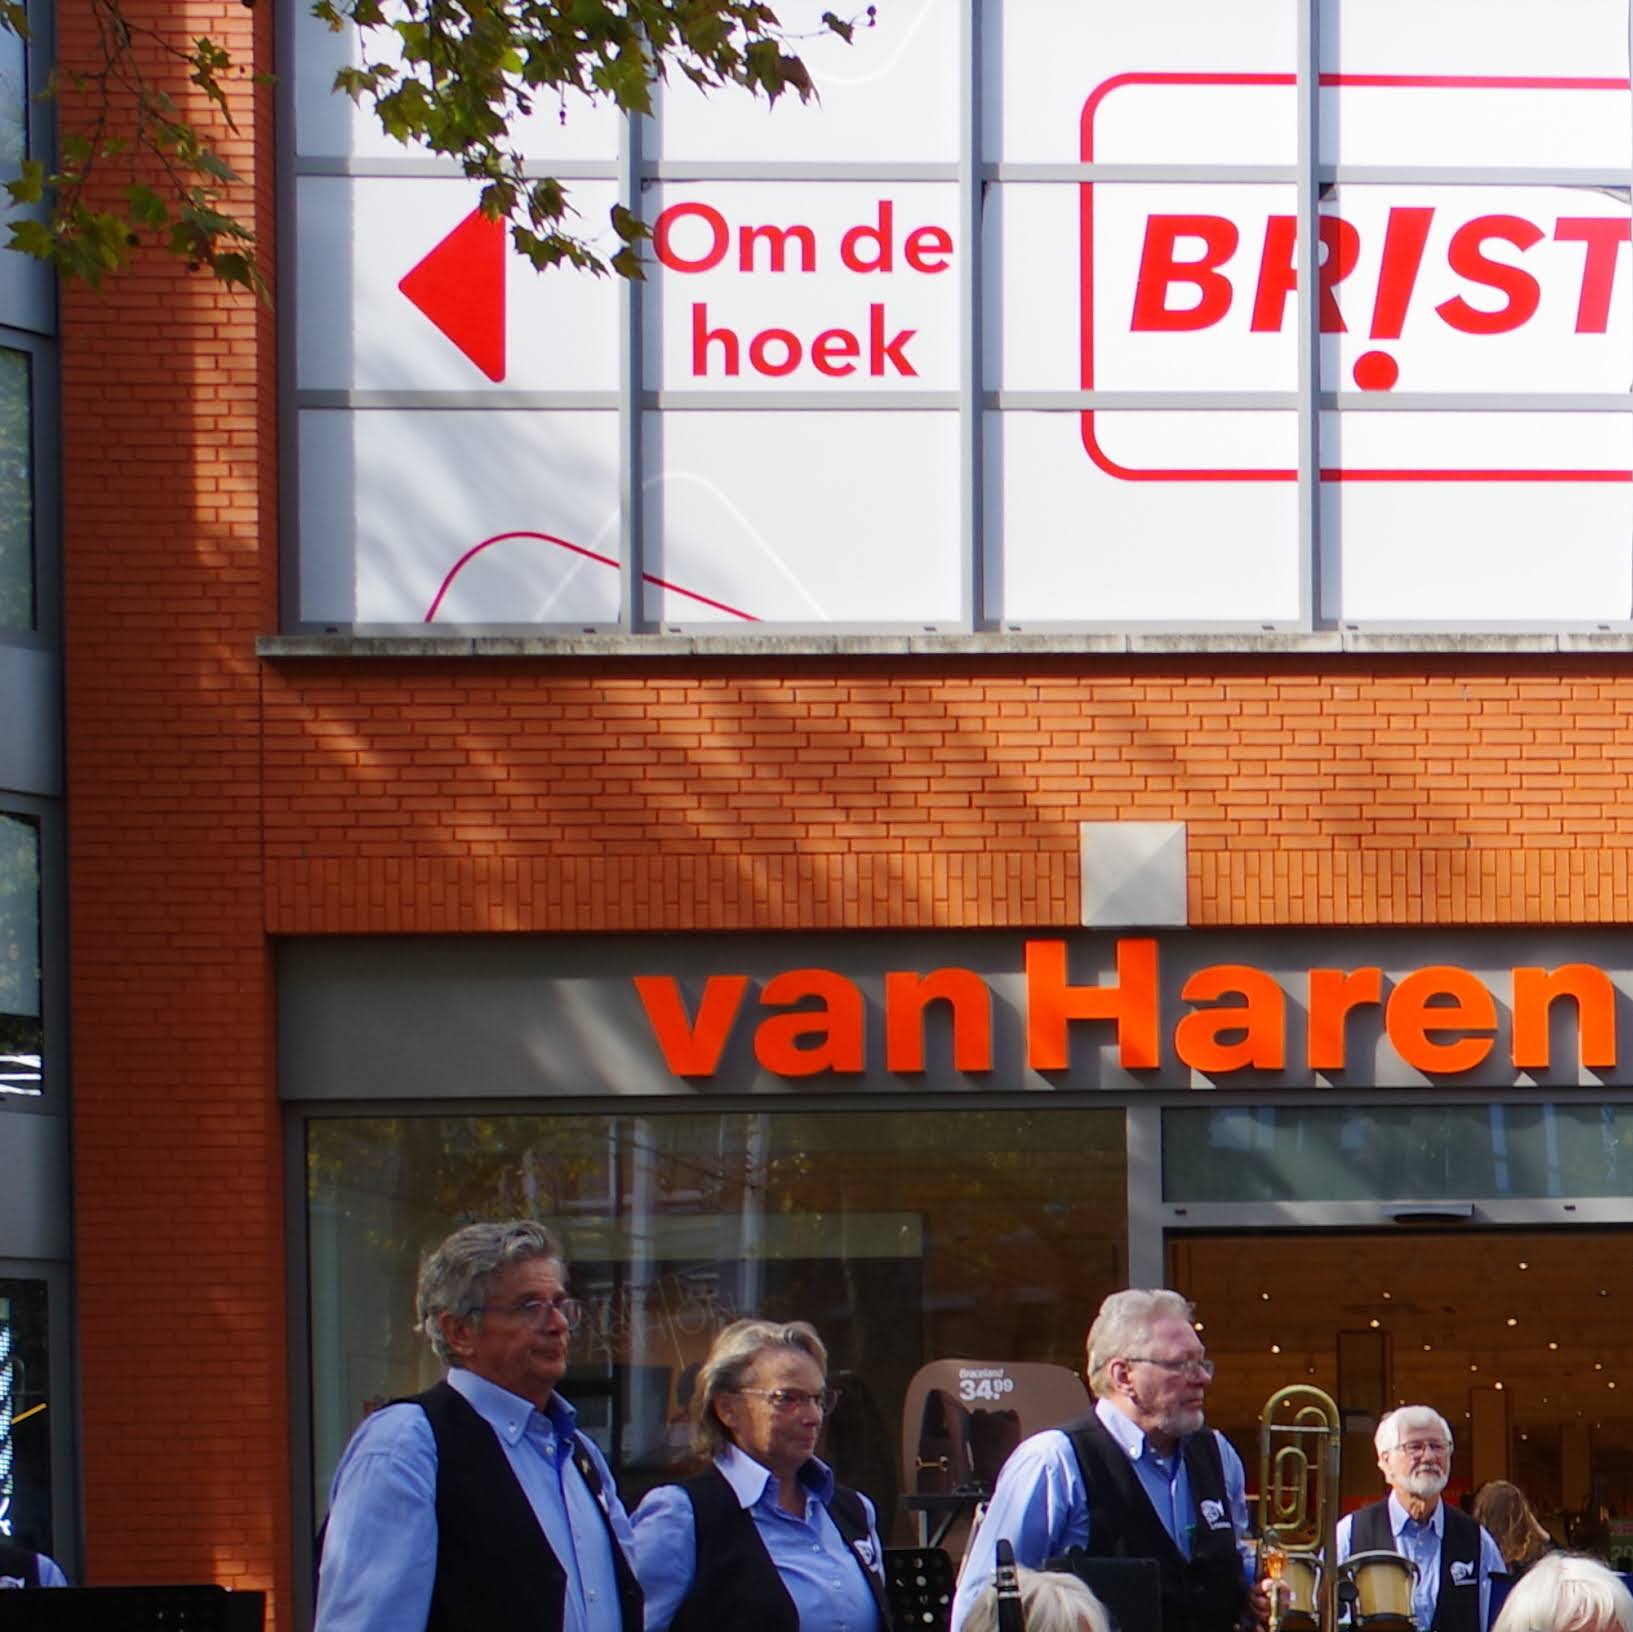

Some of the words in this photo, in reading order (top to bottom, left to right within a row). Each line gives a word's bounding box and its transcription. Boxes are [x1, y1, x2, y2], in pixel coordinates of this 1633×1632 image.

[652, 201, 817, 274] Om
[839, 199, 955, 275] de
[691, 301, 920, 378] hoek
